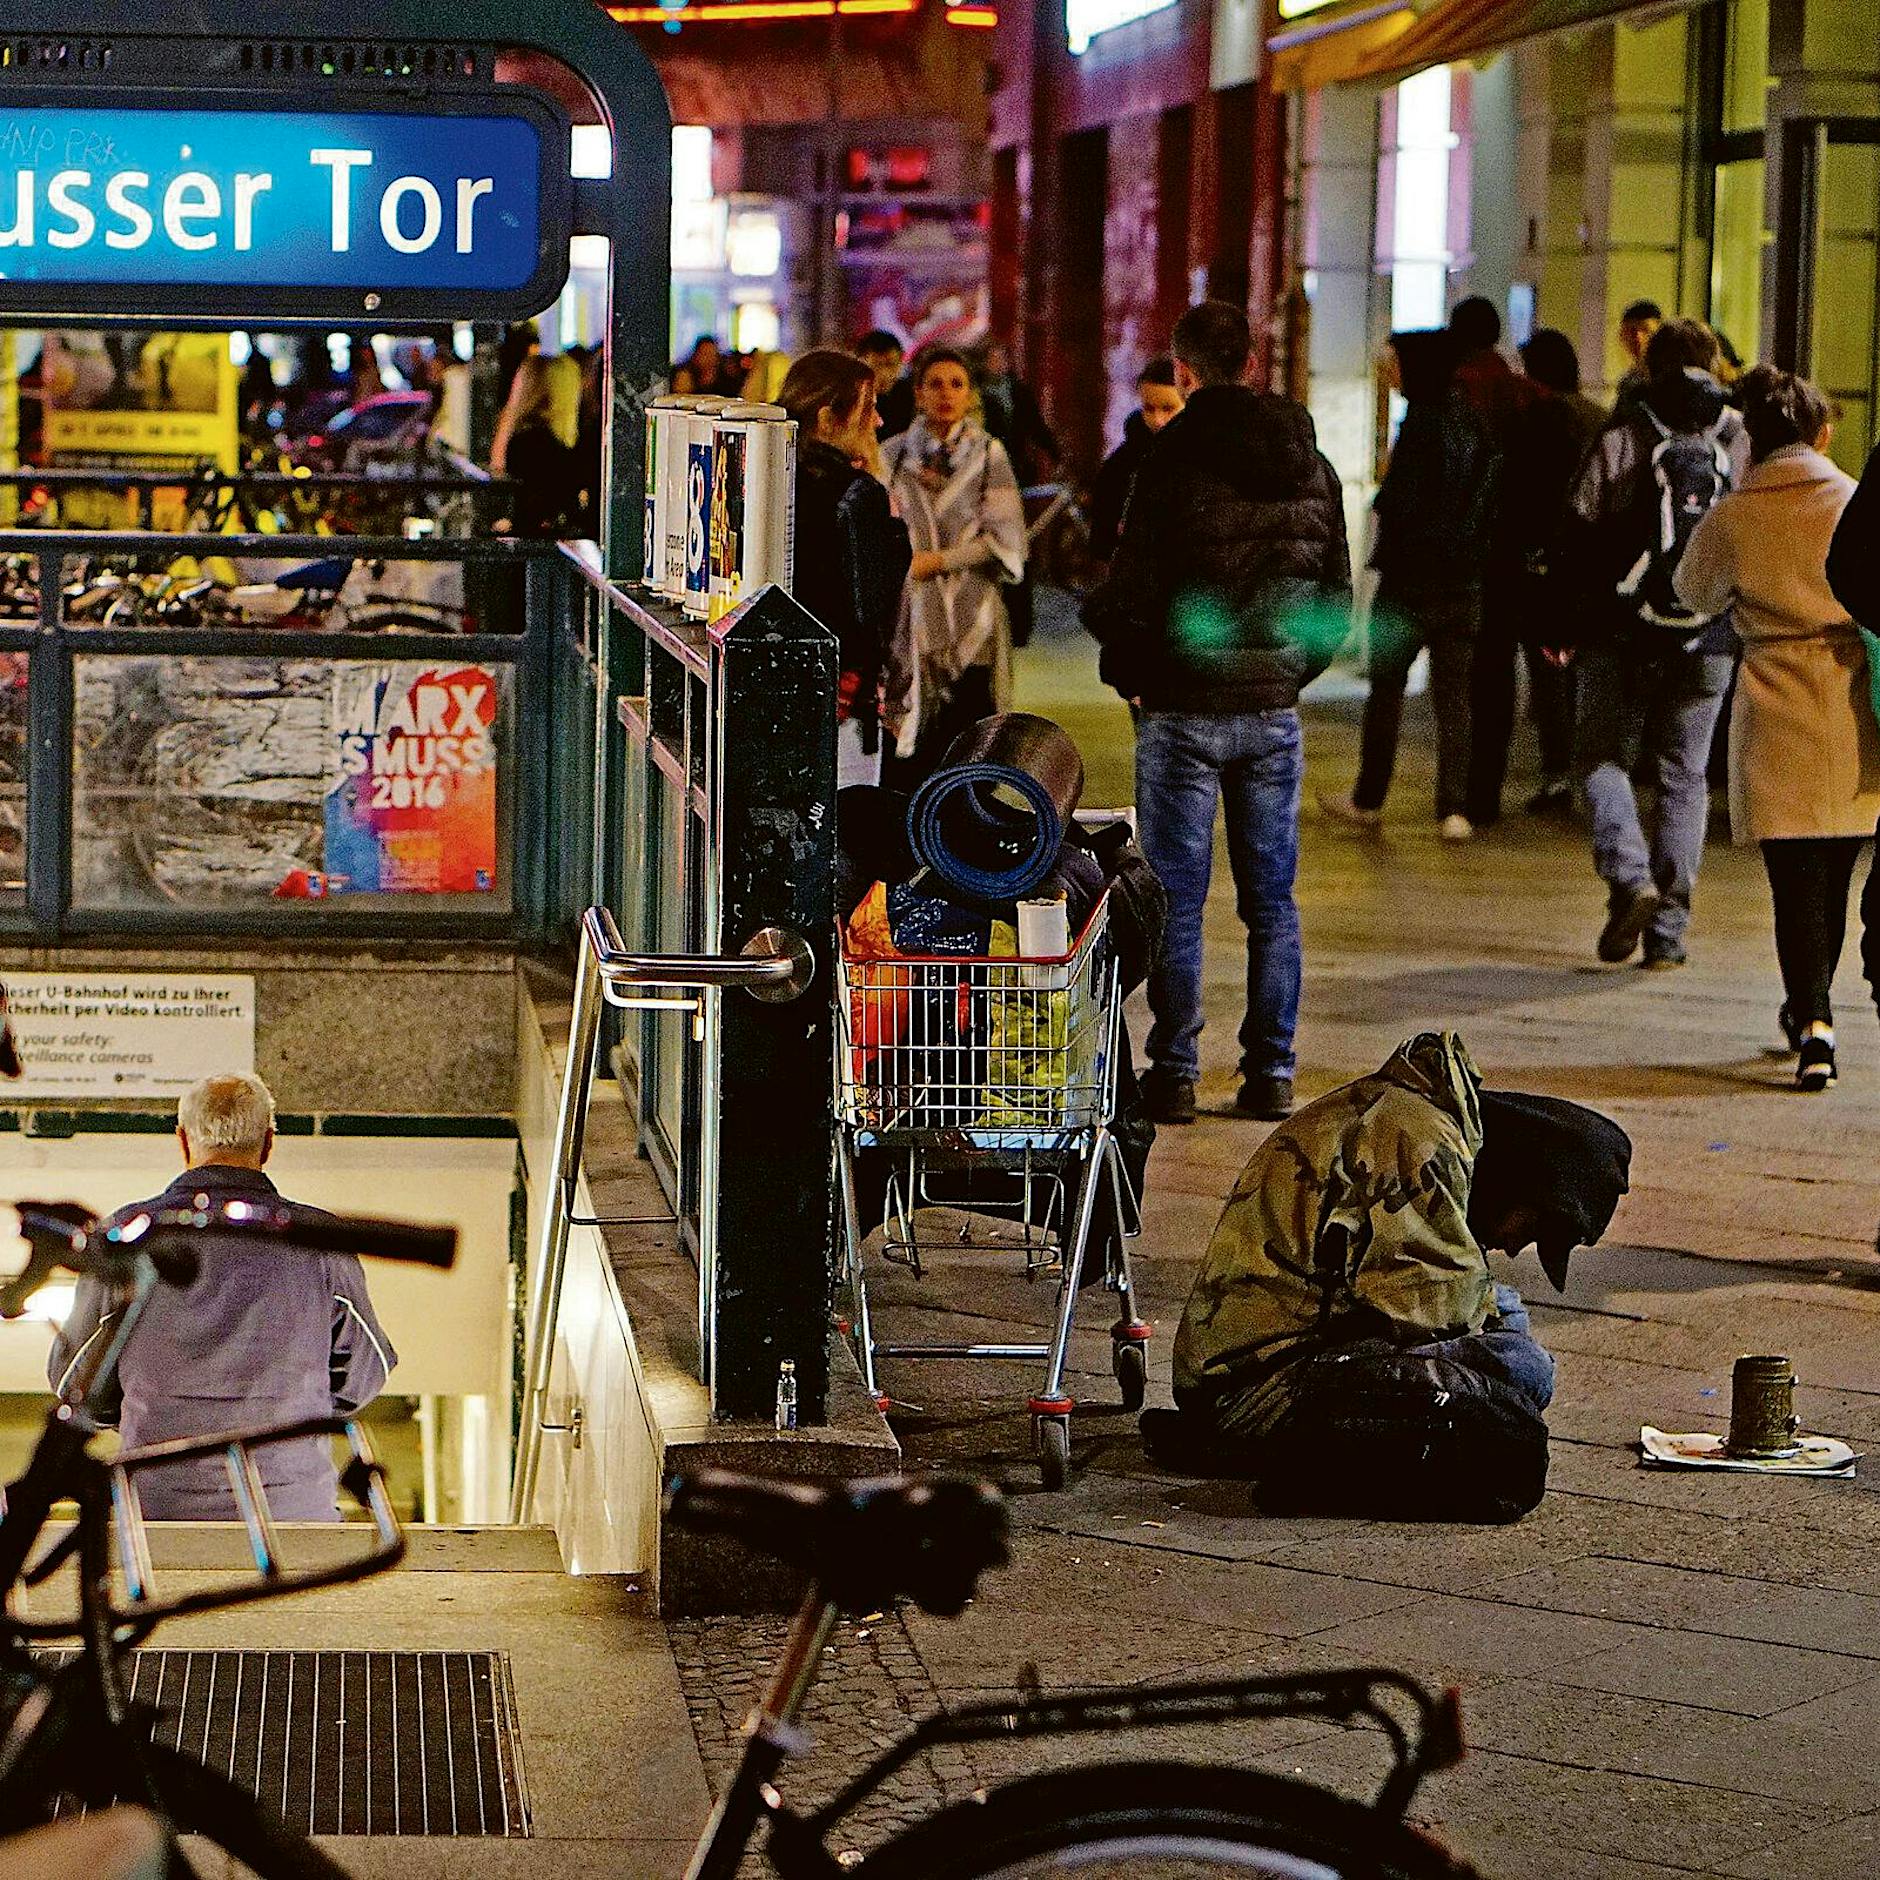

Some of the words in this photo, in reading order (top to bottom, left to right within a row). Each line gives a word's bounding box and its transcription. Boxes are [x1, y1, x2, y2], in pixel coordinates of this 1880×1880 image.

[0, 168, 272, 251] usser
[310, 149, 494, 254] Tor
[371, 775, 445, 809] 2016
[46, 984, 128, 998] U-Bahnhof
[133, 984, 168, 999] wird
[172, 988, 189, 999] zu
[194, 985, 230, 1000] Ihrer
[75, 1004, 98, 1018] per
[105, 1003, 148, 1016] Video
[24, 1036, 56, 1046] your
[90, 1052, 153, 1063] cameras
